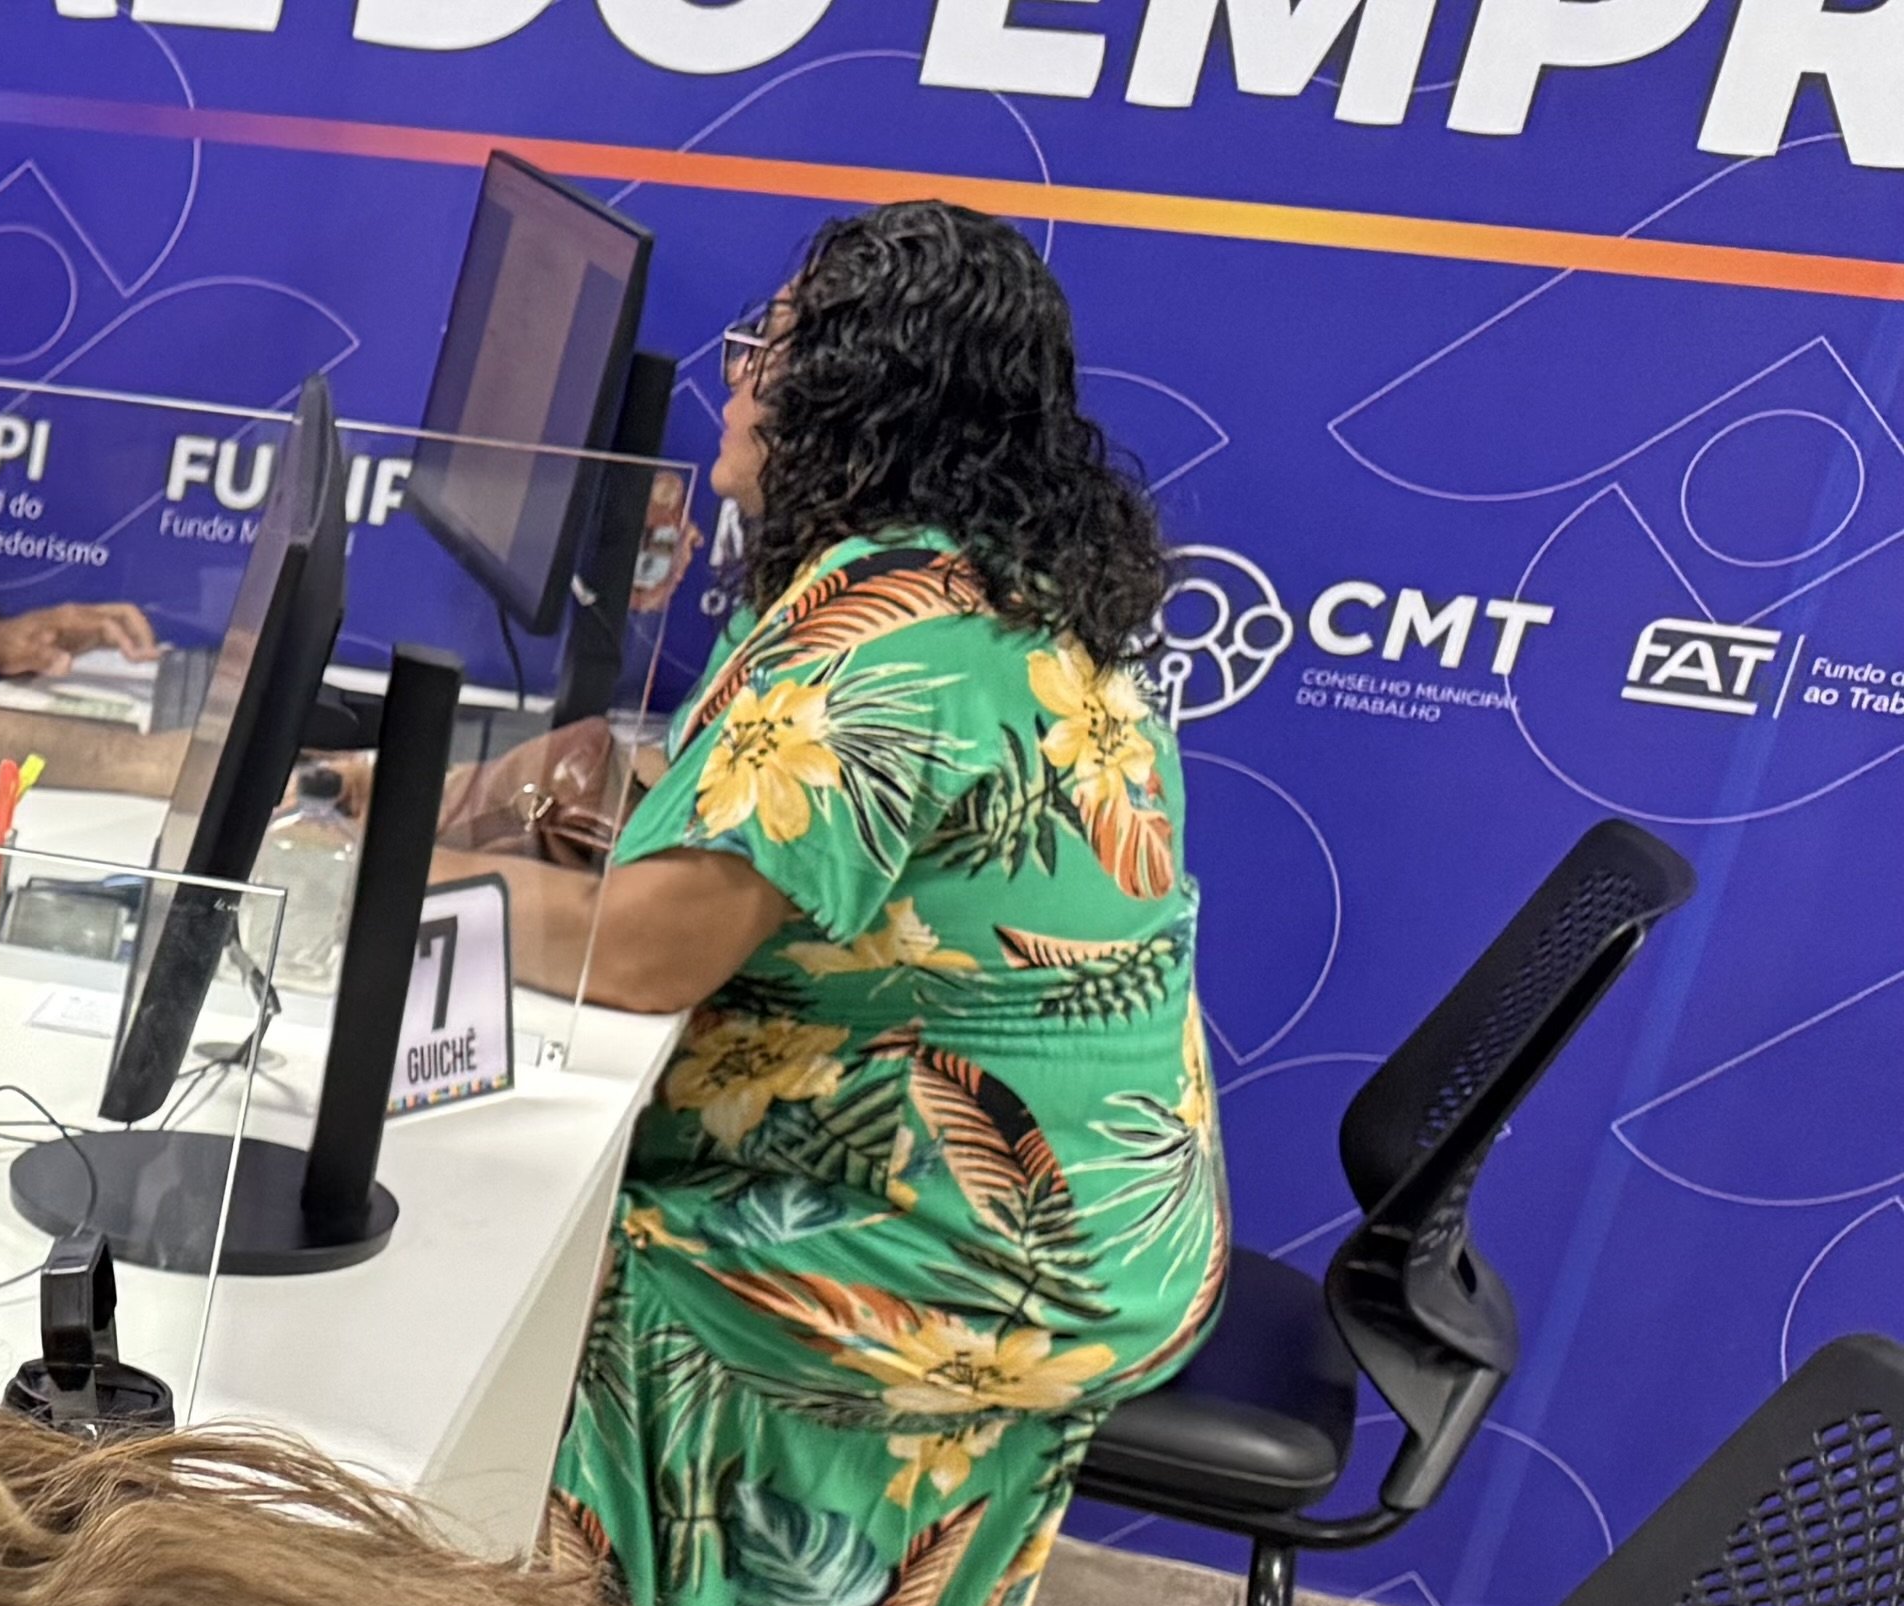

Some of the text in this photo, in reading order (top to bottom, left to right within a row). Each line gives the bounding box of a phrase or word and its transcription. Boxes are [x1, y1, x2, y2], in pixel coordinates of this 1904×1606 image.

[9, 492, 42, 520] do
[159, 510, 234, 541] Fundo
[1308, 580, 1555, 675] CMT
[1625, 618, 1777, 697] FAT
[1811, 657, 1886, 684] Fundo
[1295, 687, 1442, 723] DO TRABALHO
[1301, 668, 1520, 713] CONSELHO MUNICIPAL
[1803, 686, 1840, 706] ao
[417, 915, 458, 1033] 7
[407, 1027, 478, 1085] GUICHÊ
